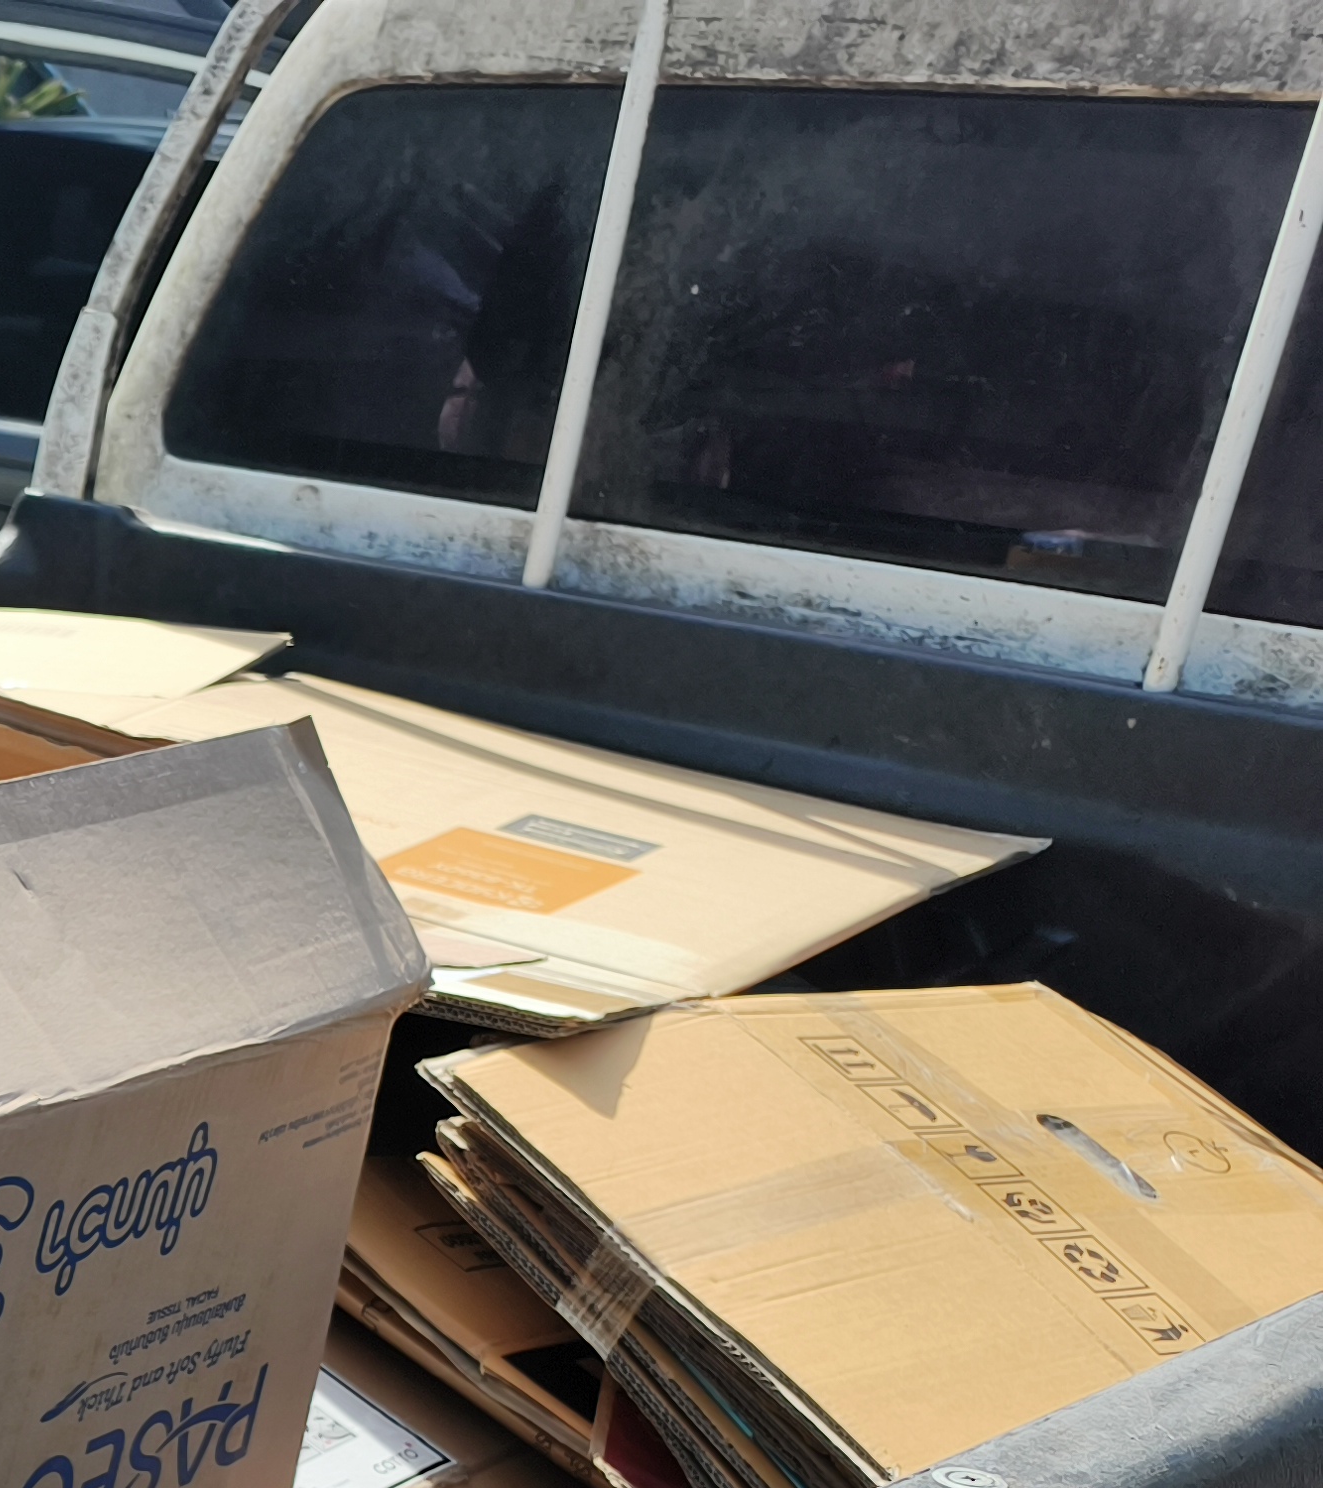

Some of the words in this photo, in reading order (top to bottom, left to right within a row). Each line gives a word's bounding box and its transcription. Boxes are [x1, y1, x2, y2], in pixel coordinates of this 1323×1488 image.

[147, 1301, 181, 1324] TISSUE
[186, 1286, 219, 1308] FACIAL
[203, 1329, 251, 1368] Fluffy
[127, 1366, 164, 1401] and
[166, 1351, 201, 1384] Soft
[77, 1382, 126, 1422] Thick
